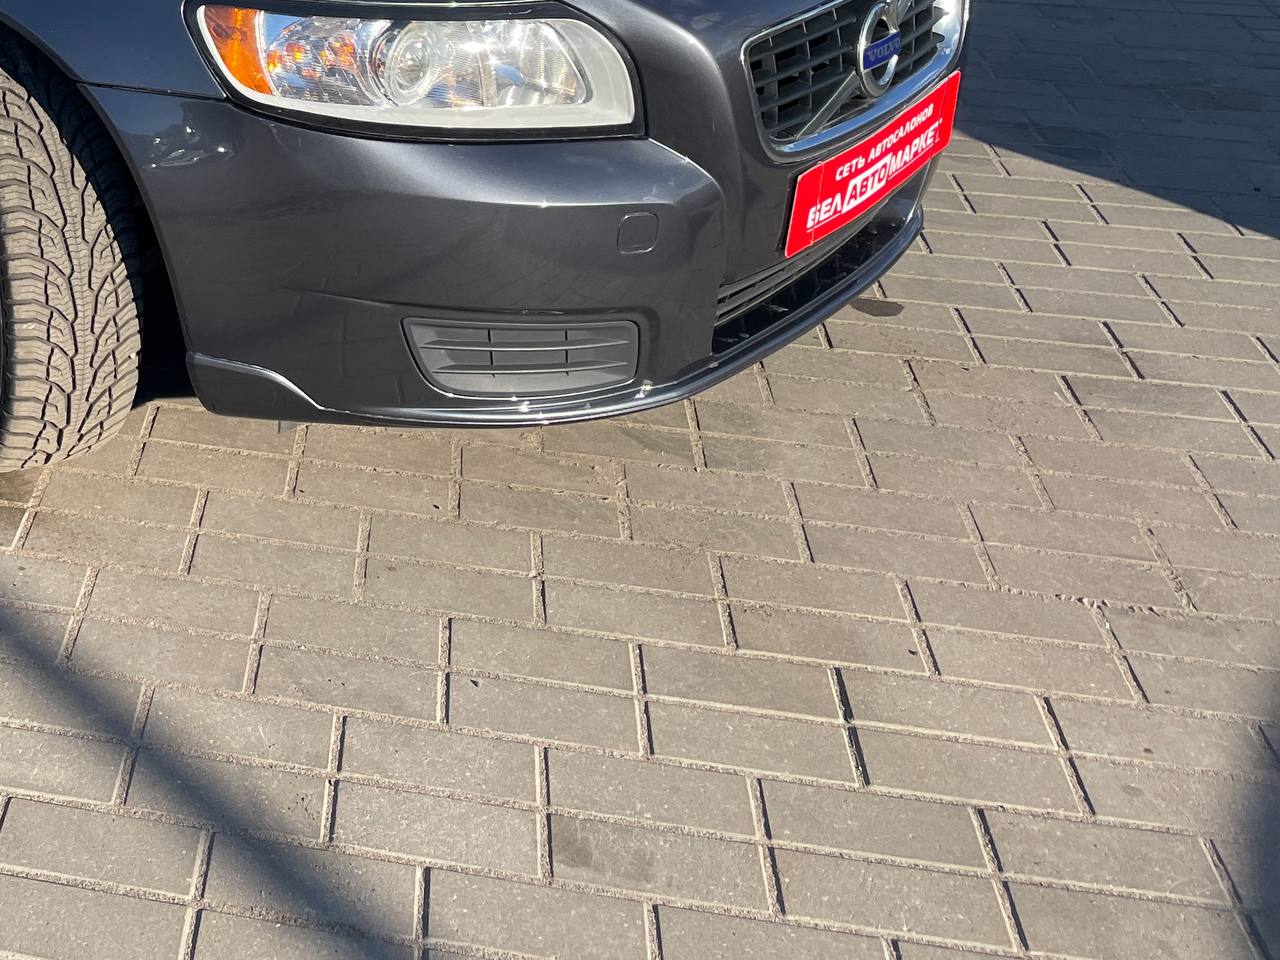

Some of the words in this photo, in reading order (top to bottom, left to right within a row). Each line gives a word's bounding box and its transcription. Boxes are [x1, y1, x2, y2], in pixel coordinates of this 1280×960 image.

[867, 37, 901, 61] VOLVO
[835, 156, 866, 181] СЕТЬ
[867, 103, 934, 163] АВТОСАЛОНОВ
